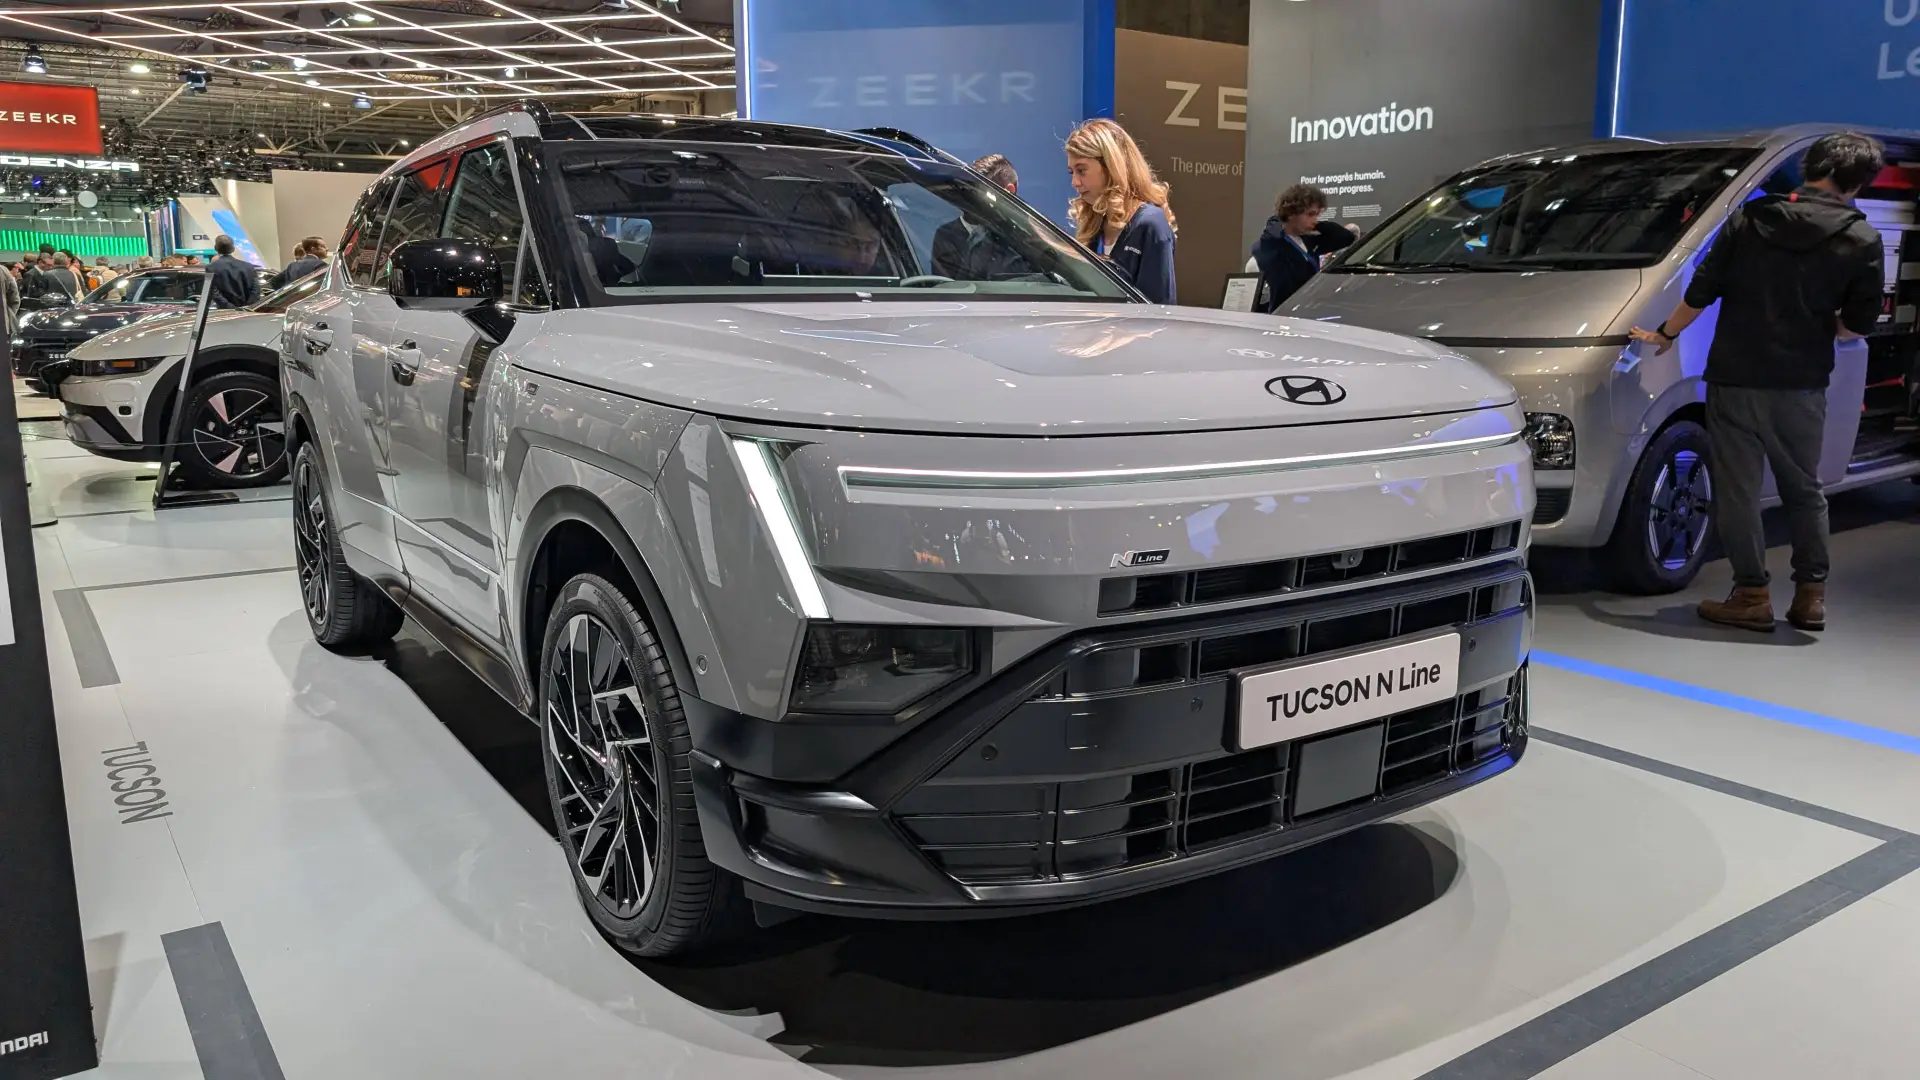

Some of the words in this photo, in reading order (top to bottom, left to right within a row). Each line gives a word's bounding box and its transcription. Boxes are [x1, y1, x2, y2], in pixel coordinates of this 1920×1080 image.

[806, 71, 1036, 108] ZEEKR
[1164, 80, 1247, 131] ZE
[0, 110, 77, 125] ZEEKR
[1290, 102, 1434, 144] Innovation
[0, 155, 139, 172] DENZA
[1171, 156, 1193, 173] The
[1195, 161, 1230, 176] power
[1231, 161, 1244, 176] of
[1300, 175, 1317, 185] Pour
[1318, 174, 1325, 184] le
[1354, 169, 1386, 181] humain.
[1320, 187, 1338, 195] man
[1339, 184, 1374, 195] progress.
[1137, 555, 1164, 563] Line
[1267, 674, 1371, 722] TUCSON
[1376, 669, 1394, 698] N
[1399, 662, 1441, 693] Line
[101, 740, 174, 825] TUCSON
